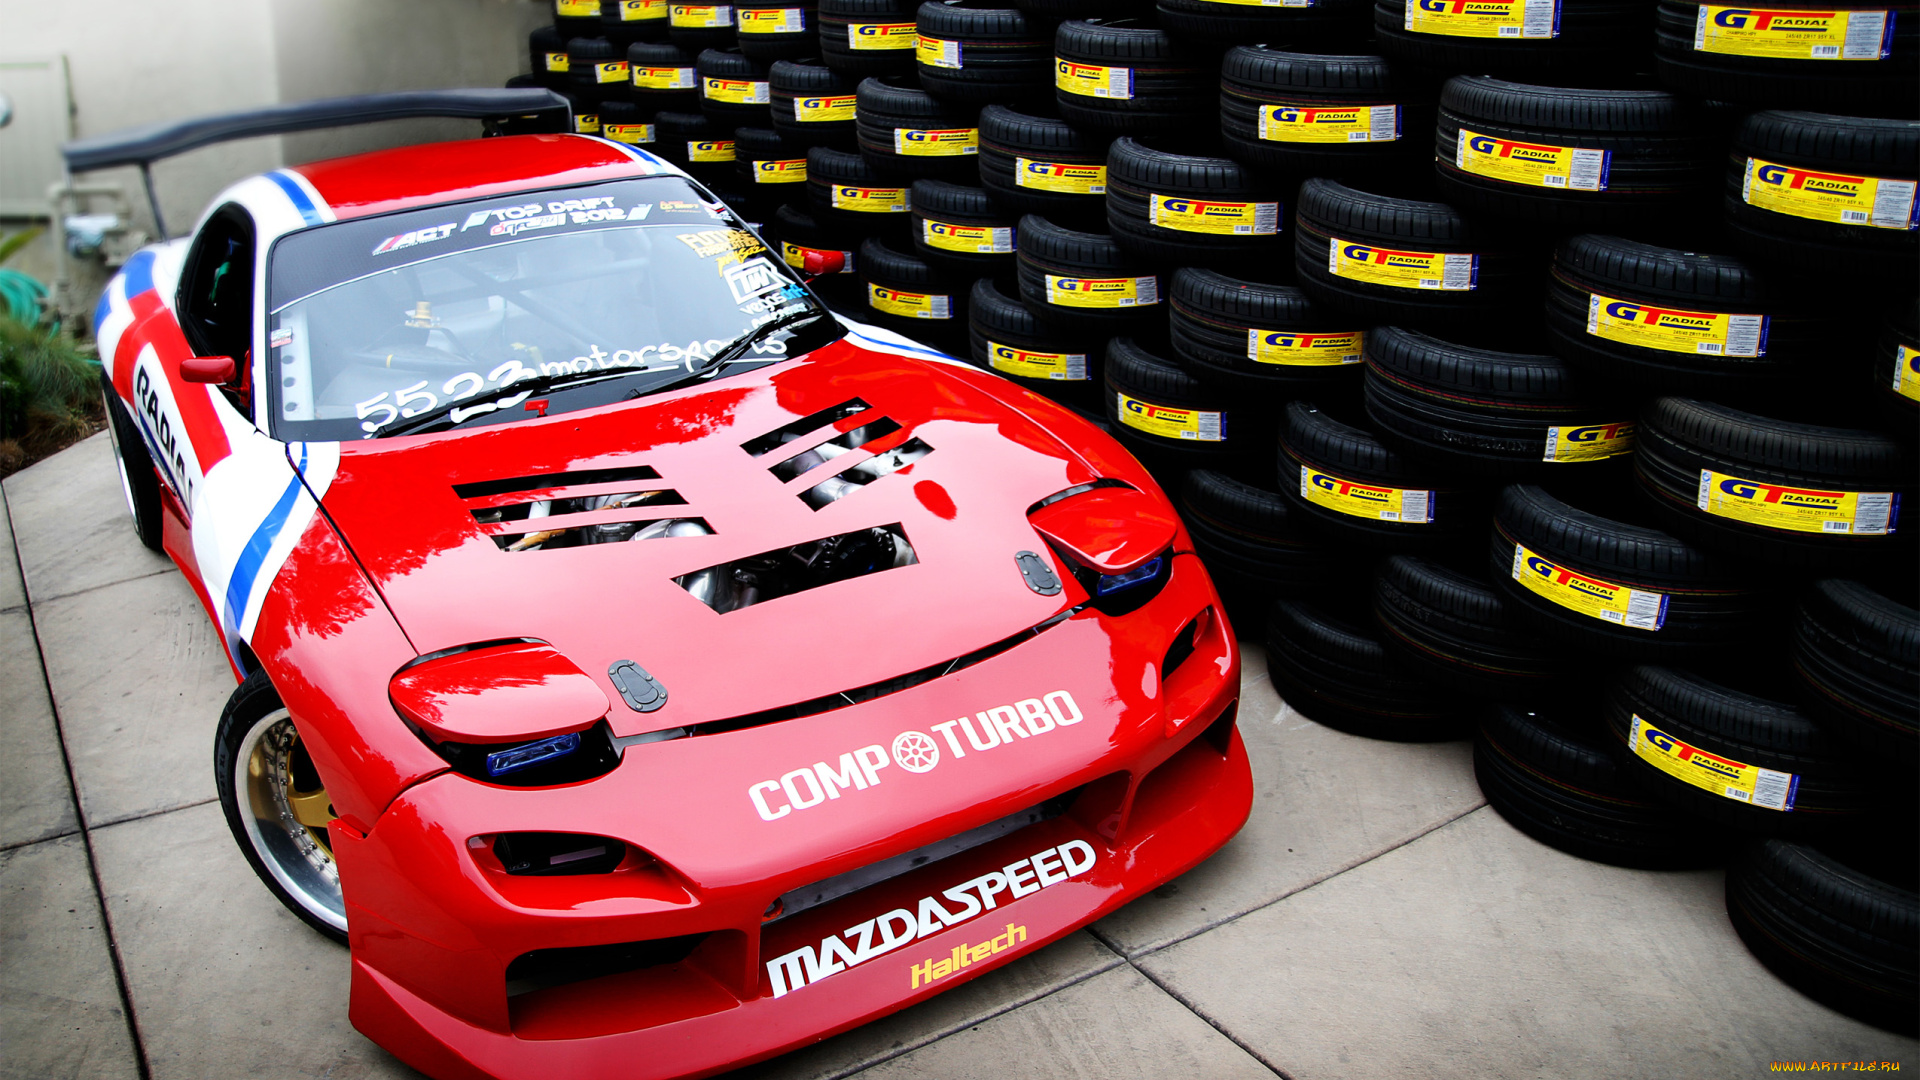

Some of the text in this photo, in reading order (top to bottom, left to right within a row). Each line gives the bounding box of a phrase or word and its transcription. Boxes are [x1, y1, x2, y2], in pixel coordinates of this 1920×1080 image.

[1773, 19, 1829, 27] RADIAL
[604, 62, 628, 71] GT
[1513, 149, 1558, 160] RADIAL
[1807, 180, 1859, 192] RADIAL
[491, 196, 615, 221] TOP DRIFT
[1205, 206, 1245, 214] RADIAL
[569, 207, 627, 224] 2012
[392, 223, 458, 249] ACT
[1389, 256, 1431, 265] RADIAL
[1092, 282, 1127, 290] RADIAL
[1661, 316, 1712, 327] RADIAL
[356, 334, 788, 433] 5523 motorspos
[1156, 410, 1188, 420] RADIAL
[1351, 487, 1391, 499] RADIAL
[1782, 494, 1840, 505] RADIAL
[1571, 579, 1616, 597] RADIAL
[748, 689, 1084, 822] COMP TURBO
[1692, 755, 1742, 776] RADIAL
[766, 839, 1097, 999] MAZDASPEED
[910, 922, 1027, 990] Haltech
